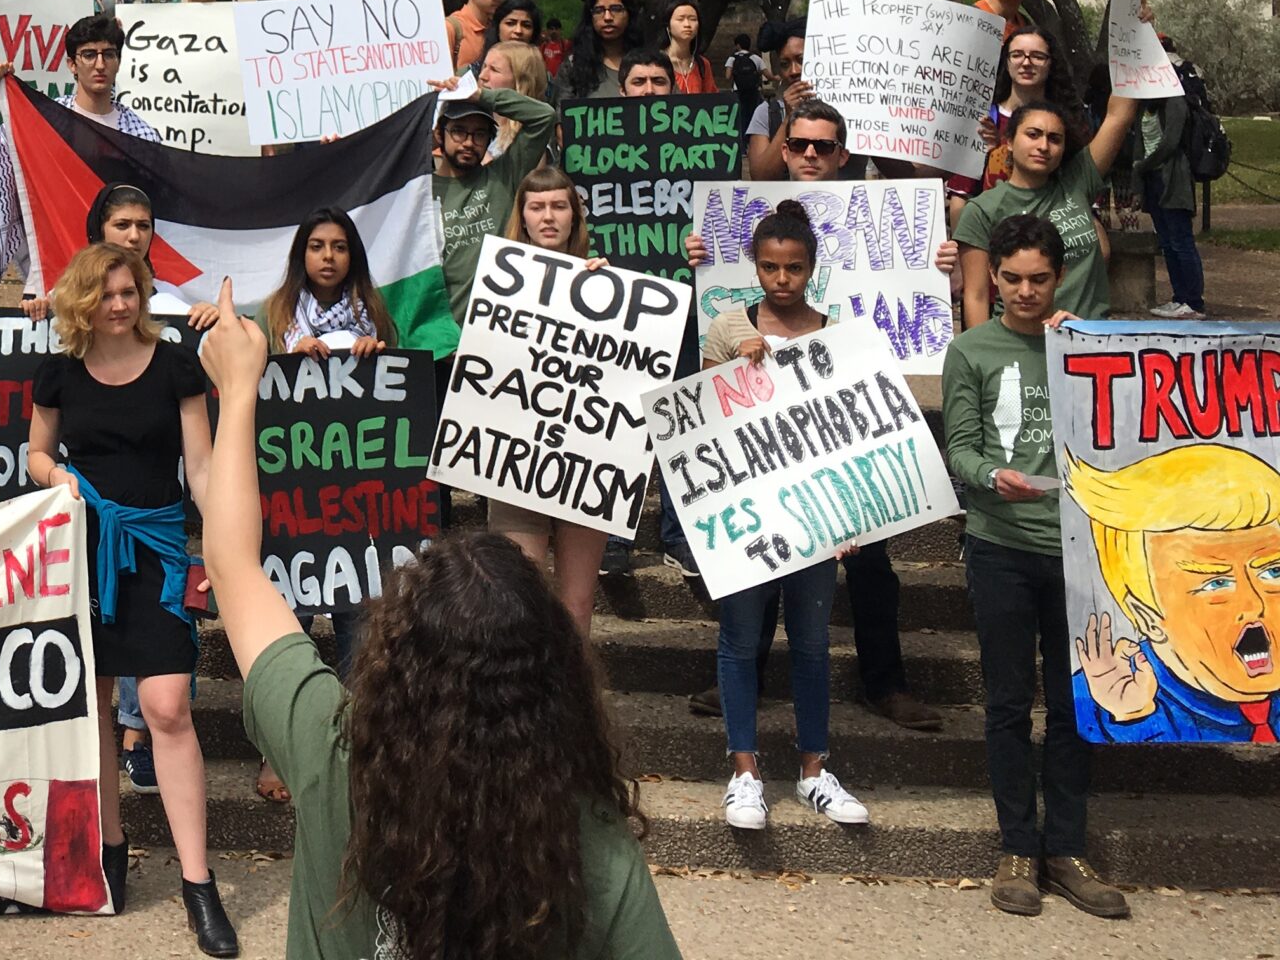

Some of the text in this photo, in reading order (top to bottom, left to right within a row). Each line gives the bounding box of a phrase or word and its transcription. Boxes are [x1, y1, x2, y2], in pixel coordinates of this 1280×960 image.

[124, 20, 228, 55] Gaza
[261, 4, 334, 55] SAY
[899, 16, 913, 26] TO
[130, 58, 183, 85] is a
[245, 39, 441, 89] TO STATE-SANCTIONED
[807, 34, 849, 58] THE
[856, 34, 921, 60] SOULS
[931, 44, 964, 68] ARE
[803, 60, 994, 102] COLLECTION OF ARMED FORCES
[849, 77, 896, 92] AMONG
[902, 82, 935, 97] THEM
[565, 101, 740, 139] THE ISRAEL
[879, 93, 902, 107] WITH
[904, 95, 926, 109] ONE
[930, 97, 968, 119] ANOTHER
[889, 106, 936, 122] UNITED
[848, 119, 989, 154] THOSE WHO ARE NOT ARE
[856, 133, 943, 159] DISUNITED
[565, 142, 739, 175] BLOCK PARTY
[699, 184, 937, 271] NO BAN
[482, 245, 679, 332] STOP
[468, 297, 672, 381] PRETENDING
[528, 345, 604, 395] YOUR
[652, 338, 835, 442] SAY NO TO
[451, 353, 654, 452] RACISM
[257, 416, 430, 474] SRAEL
[534, 420, 567, 448] IS
[667, 370, 922, 508] ISLAMOPHOBIA
[432, 418, 648, 531] PATRIOTISM
[694, 497, 763, 551] YES
[744, 532, 793, 573] TO
